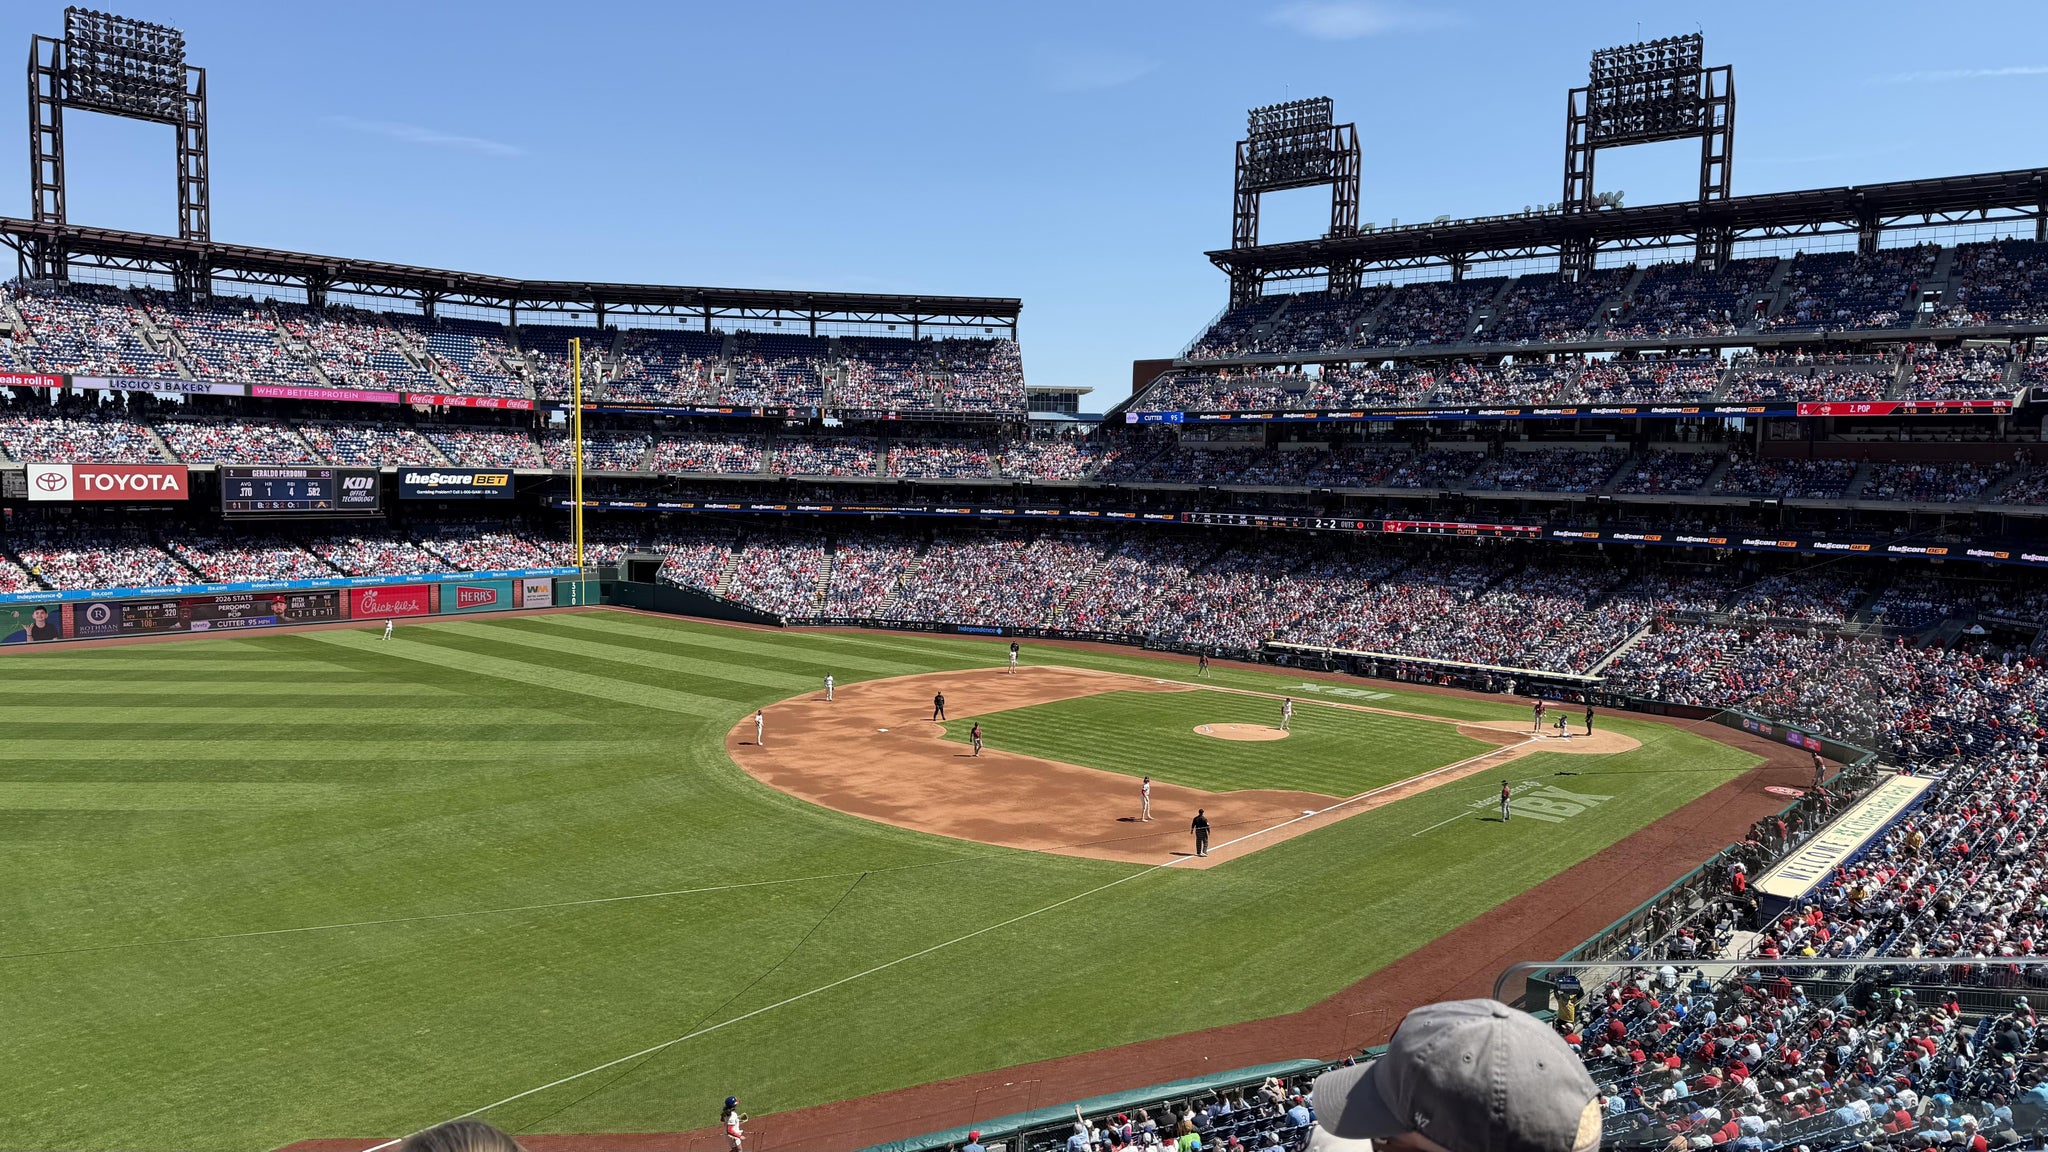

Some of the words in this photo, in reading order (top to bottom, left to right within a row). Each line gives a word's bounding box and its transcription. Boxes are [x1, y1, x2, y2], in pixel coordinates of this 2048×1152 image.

[24, 376, 42, 386] roll
[43, 377, 54, 386] in
[110, 380, 160, 390] LISCIO'S
[165, 382, 211, 392] BAKERY
[256, 387, 285, 395] WHEY
[287, 389, 318, 397] BETTER
[322, 391, 359, 399] PROTEIN
[1850, 405, 1856, 413] Z.
[1857, 405, 1871, 413] POP
[80, 473, 179, 491] TOYOTA
[342, 477, 374, 490] KDI
[405, 473, 473, 486] theScore
[476, 476, 506, 484] BET
[267, 488, 272, 497] 1
[289, 488, 294, 496] 4
[1503, 530, 1582, 538] theScore
[1814, 542, 1849, 550] theScore
[1888, 545, 1926, 553] theScore
[1966, 549, 1994, 557] theScore
[527, 585, 549, 593] WM
[461, 590, 492, 602] HERR'S
[95, 609, 104, 618] R
[163, 608, 177, 617] .320
[312, 609, 317, 617] 8
[326, 608, 333, 616] 11
[217, 620, 245, 628] CUTTER
[957, 625, 996, 633] Independence
[1882, 784, 1919, 797] Park
[1491, 785, 1615, 824] IBX
[1867, 794, 1905, 809] Bank
[1841, 807, 1889, 831] Citizens
[1777, 840, 1850, 881] WELCOME
